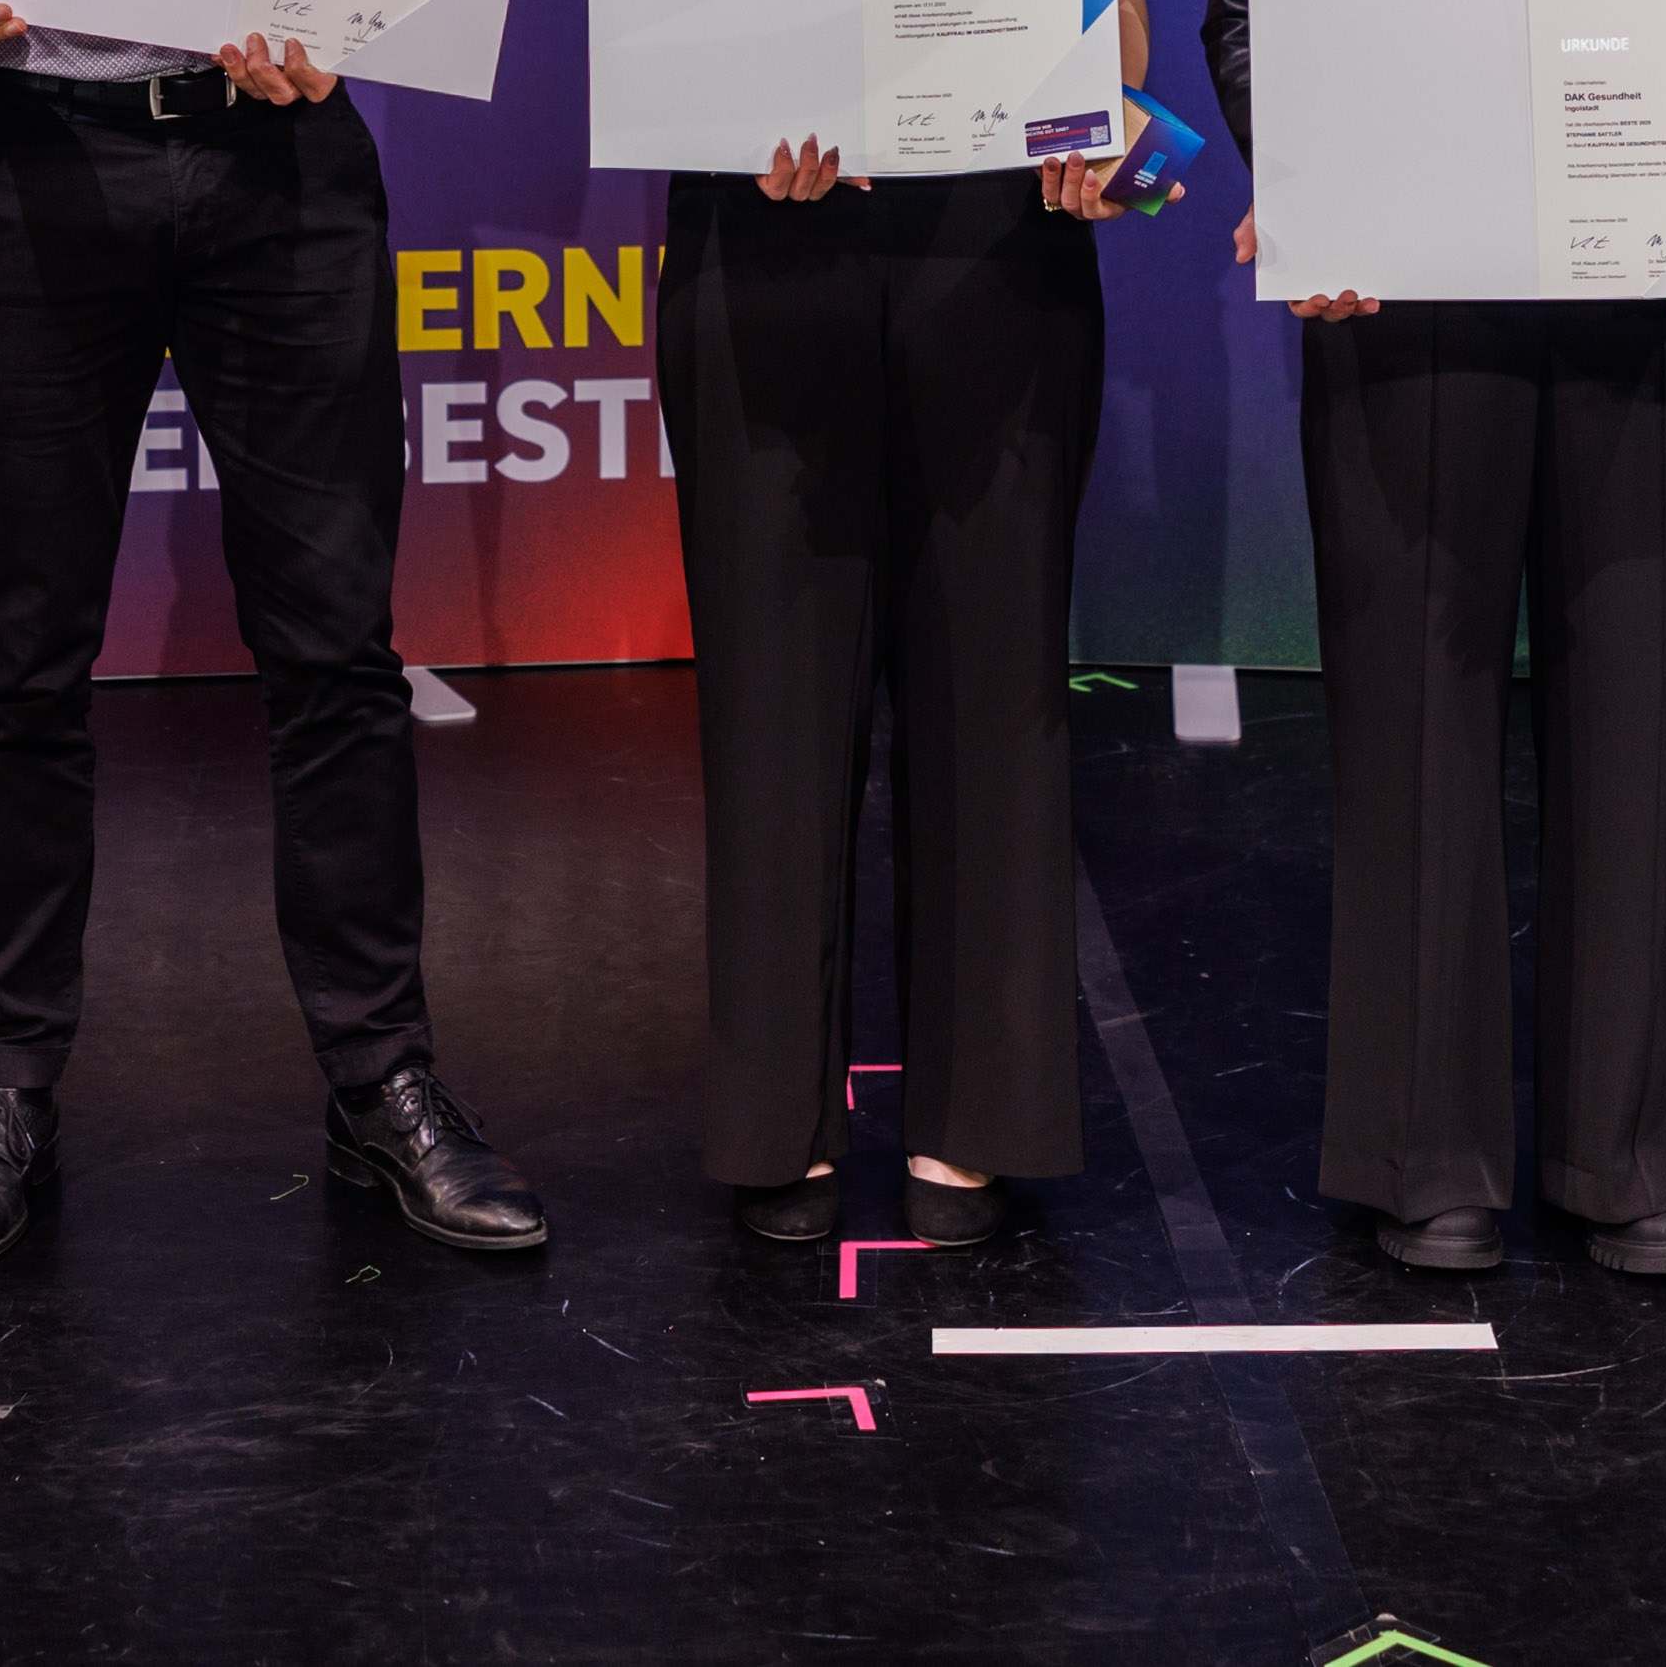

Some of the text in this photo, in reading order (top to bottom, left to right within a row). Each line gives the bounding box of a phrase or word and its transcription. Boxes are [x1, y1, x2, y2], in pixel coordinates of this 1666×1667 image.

[1560, 37, 1630, 52] URKUNDE
[1565, 92, 1641, 101] DAK Gesundheit
